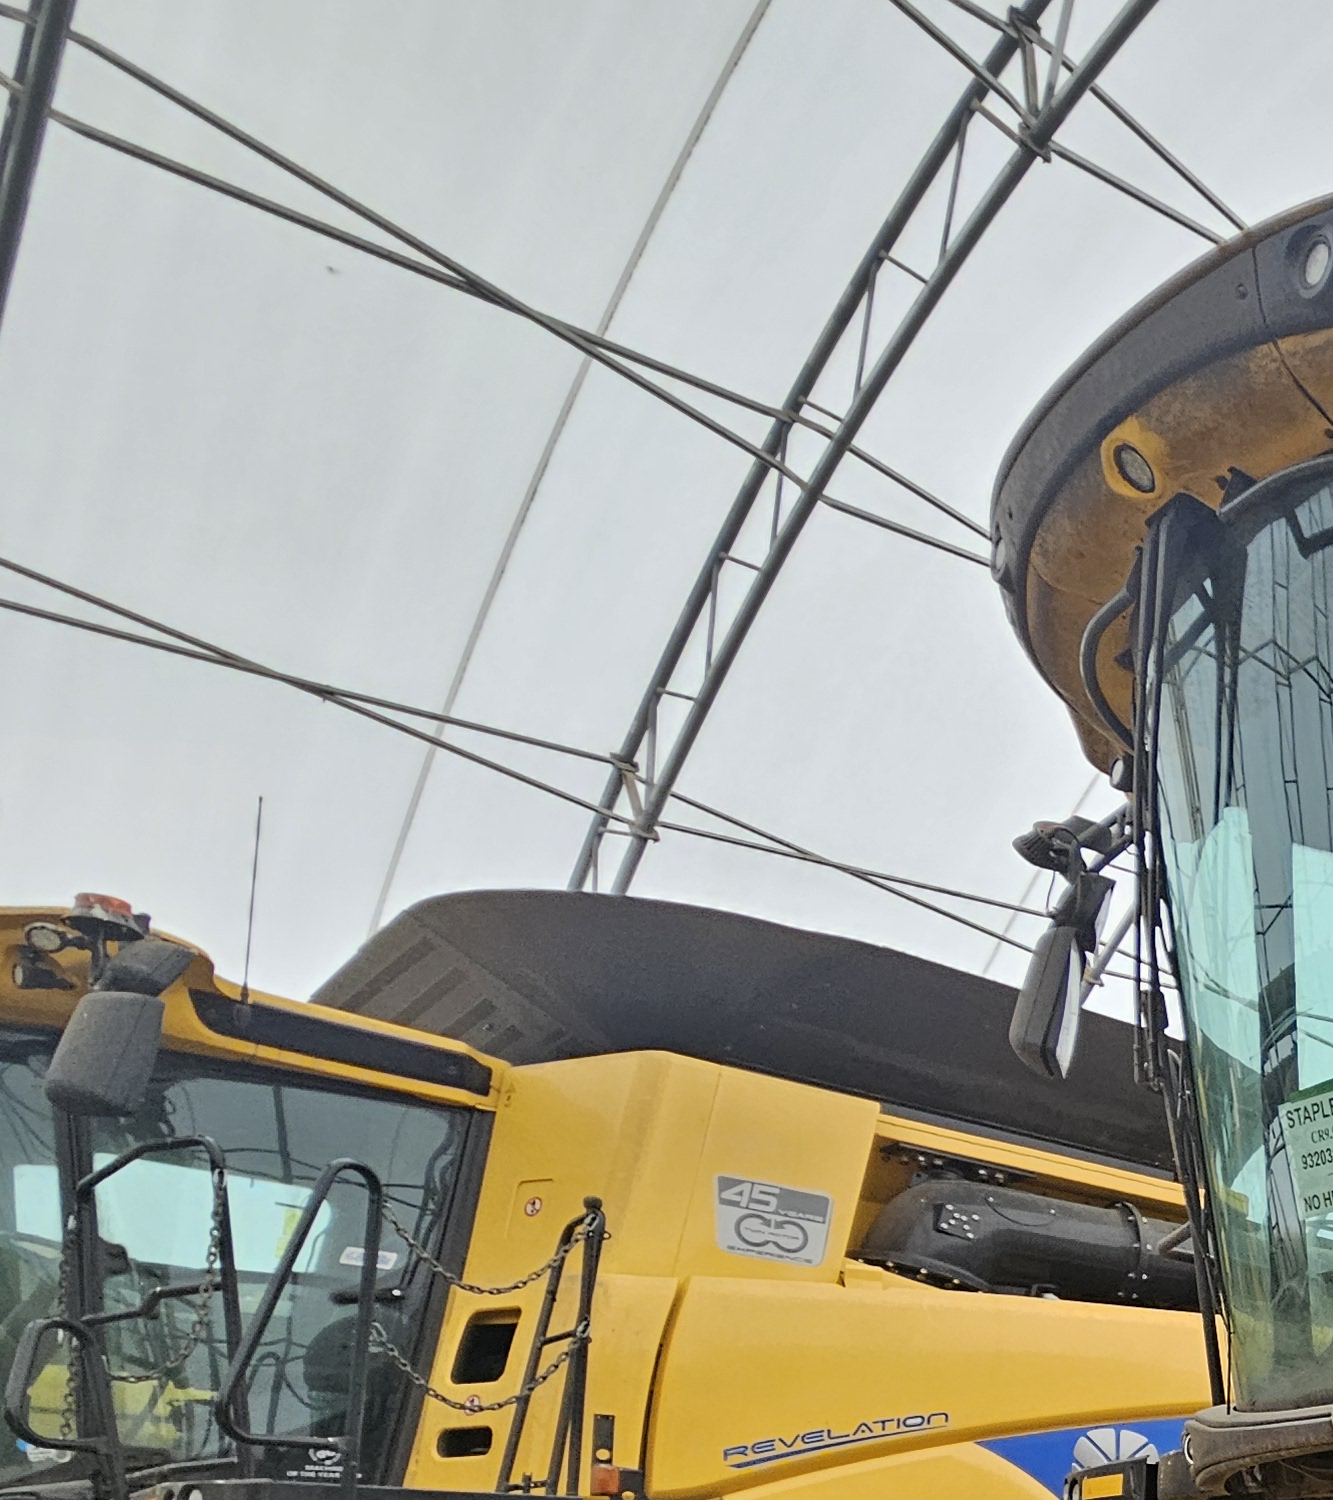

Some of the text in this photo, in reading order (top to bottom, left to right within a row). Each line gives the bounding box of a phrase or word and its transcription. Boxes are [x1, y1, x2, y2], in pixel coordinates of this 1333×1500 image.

[721, 1182, 781, 1213] 45
[1303, 1194, 1321, 1213] NO
[722, 1411, 950, 1462] REVELATION
